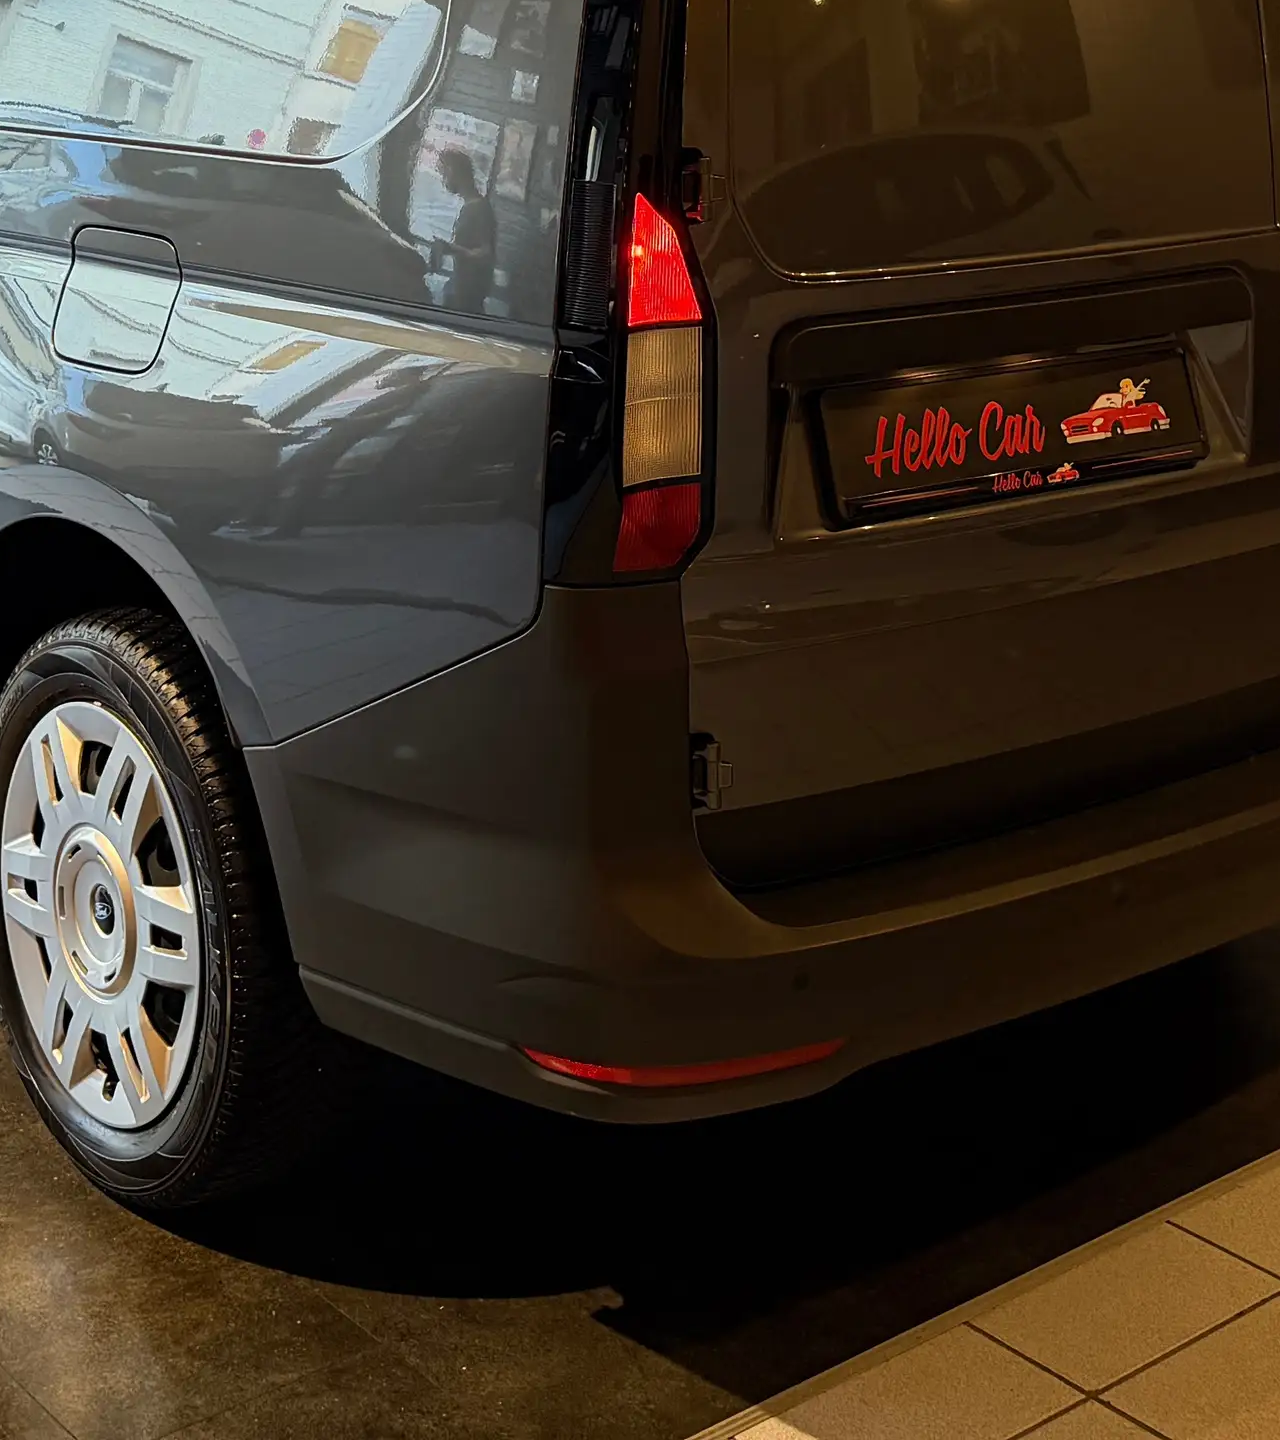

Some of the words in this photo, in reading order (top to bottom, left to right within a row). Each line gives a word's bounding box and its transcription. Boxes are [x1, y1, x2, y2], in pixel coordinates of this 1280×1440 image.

[864, 406, 972, 478] Hello
[979, 400, 1046, 461] Car
[991, 472, 1020, 493] Hello
[1023, 471, 1042, 487] Car
